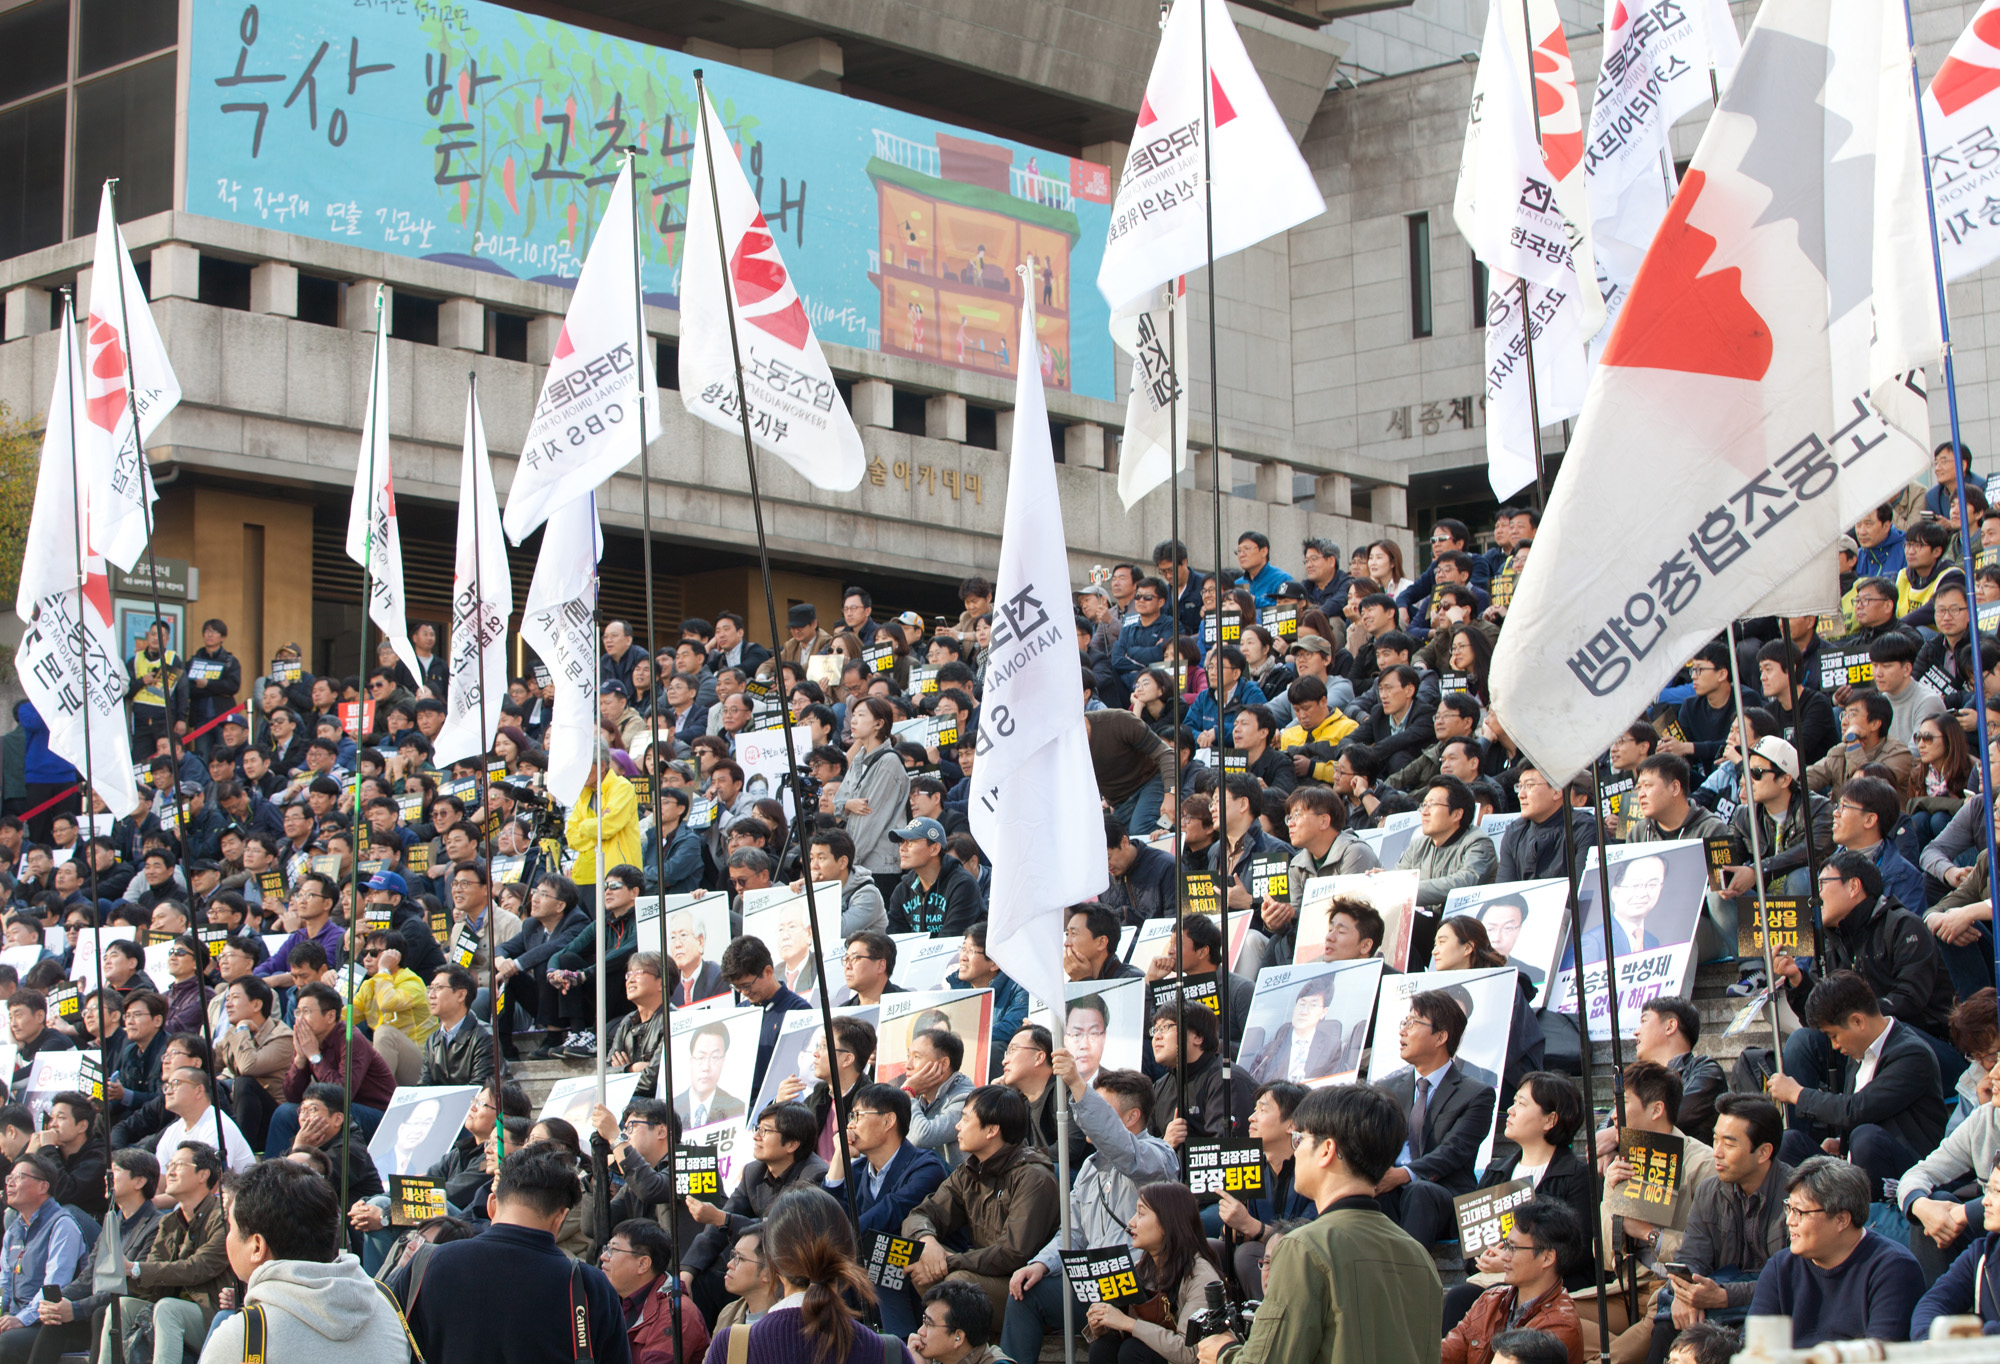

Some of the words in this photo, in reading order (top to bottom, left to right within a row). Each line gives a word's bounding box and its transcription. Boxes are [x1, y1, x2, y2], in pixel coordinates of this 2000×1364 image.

[214, 4, 396, 158] 옥상
[217, 178, 242, 212] 작
[326, 200, 362, 235] 연출
[686, 1155, 716, 1172] 김장겸은
[1189, 1151, 1218, 1168] 고대영
[1220, 1149, 1261, 1166] 김장겸은
[1460, 1204, 1492, 1228] 고대영
[1493, 1185, 1533, 1215] 김장겸은
[1065, 1262, 1091, 1281] 고대영
[1090, 1254, 1132, 1277] 김장겸은
[574, 1304, 588, 1349] Canon
